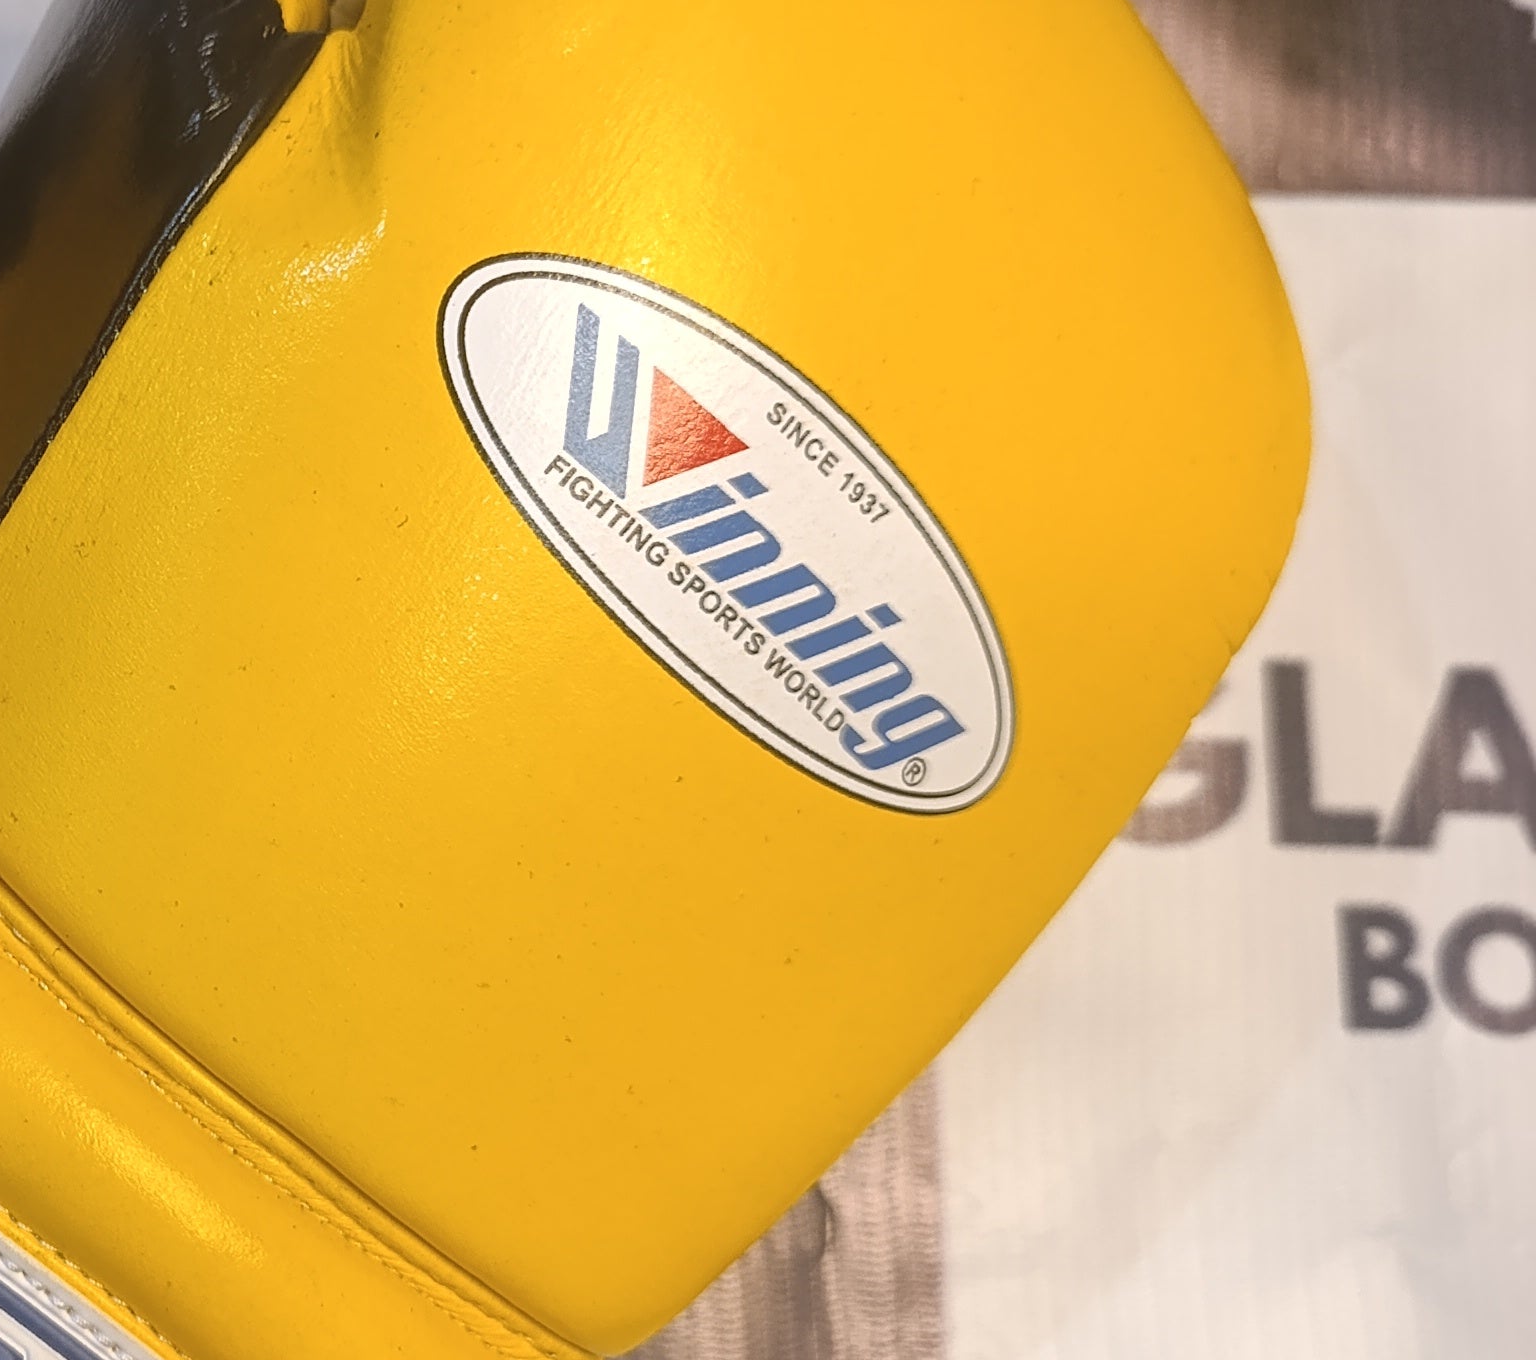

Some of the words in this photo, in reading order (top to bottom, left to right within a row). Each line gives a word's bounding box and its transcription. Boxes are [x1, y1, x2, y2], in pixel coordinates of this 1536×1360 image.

[544, 454, 670, 567] FIGHTING
[667, 560, 766, 656] SPORTS
[763, 647, 845, 735] WORLD
[563, 302, 966, 771] Winning
[765, 400, 838, 478] SINCE
[838, 470, 891, 526] 1937
